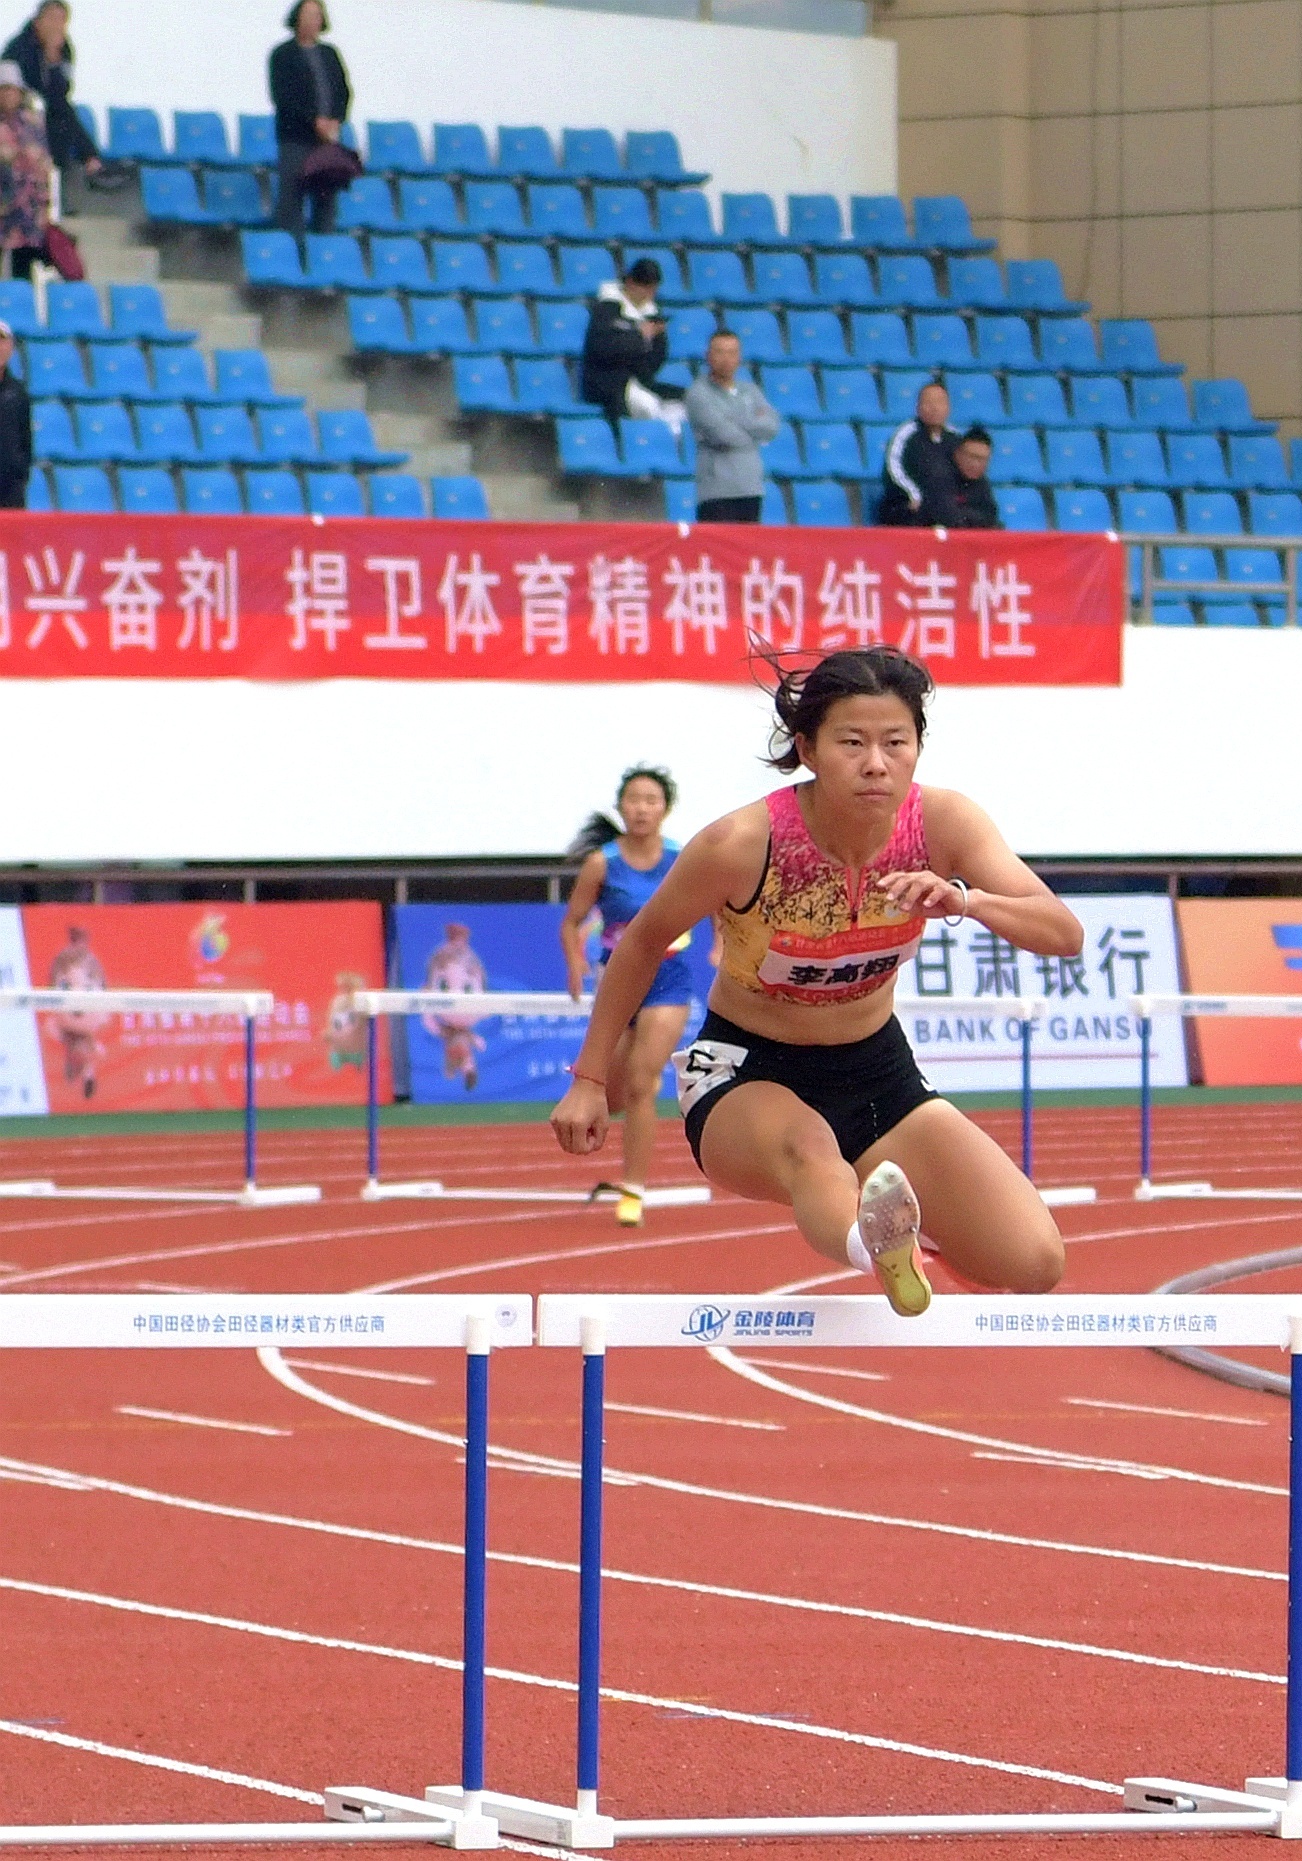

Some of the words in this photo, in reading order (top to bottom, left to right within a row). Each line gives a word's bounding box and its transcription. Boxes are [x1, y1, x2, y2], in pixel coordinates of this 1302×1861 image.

[0, 546, 239, 652] 兴奋剂
[286, 548, 1037, 660] 捍卫体育精神的纯洁性
[915, 1017, 996, 1043] BANK
[133, 1314, 386, 1334] 中国田径协会田径器材类官方供应商
[734, 1310, 816, 1328] 金陵体育
[975, 1313, 1218, 1333] 中国田径协会田径器材类官方供应商
